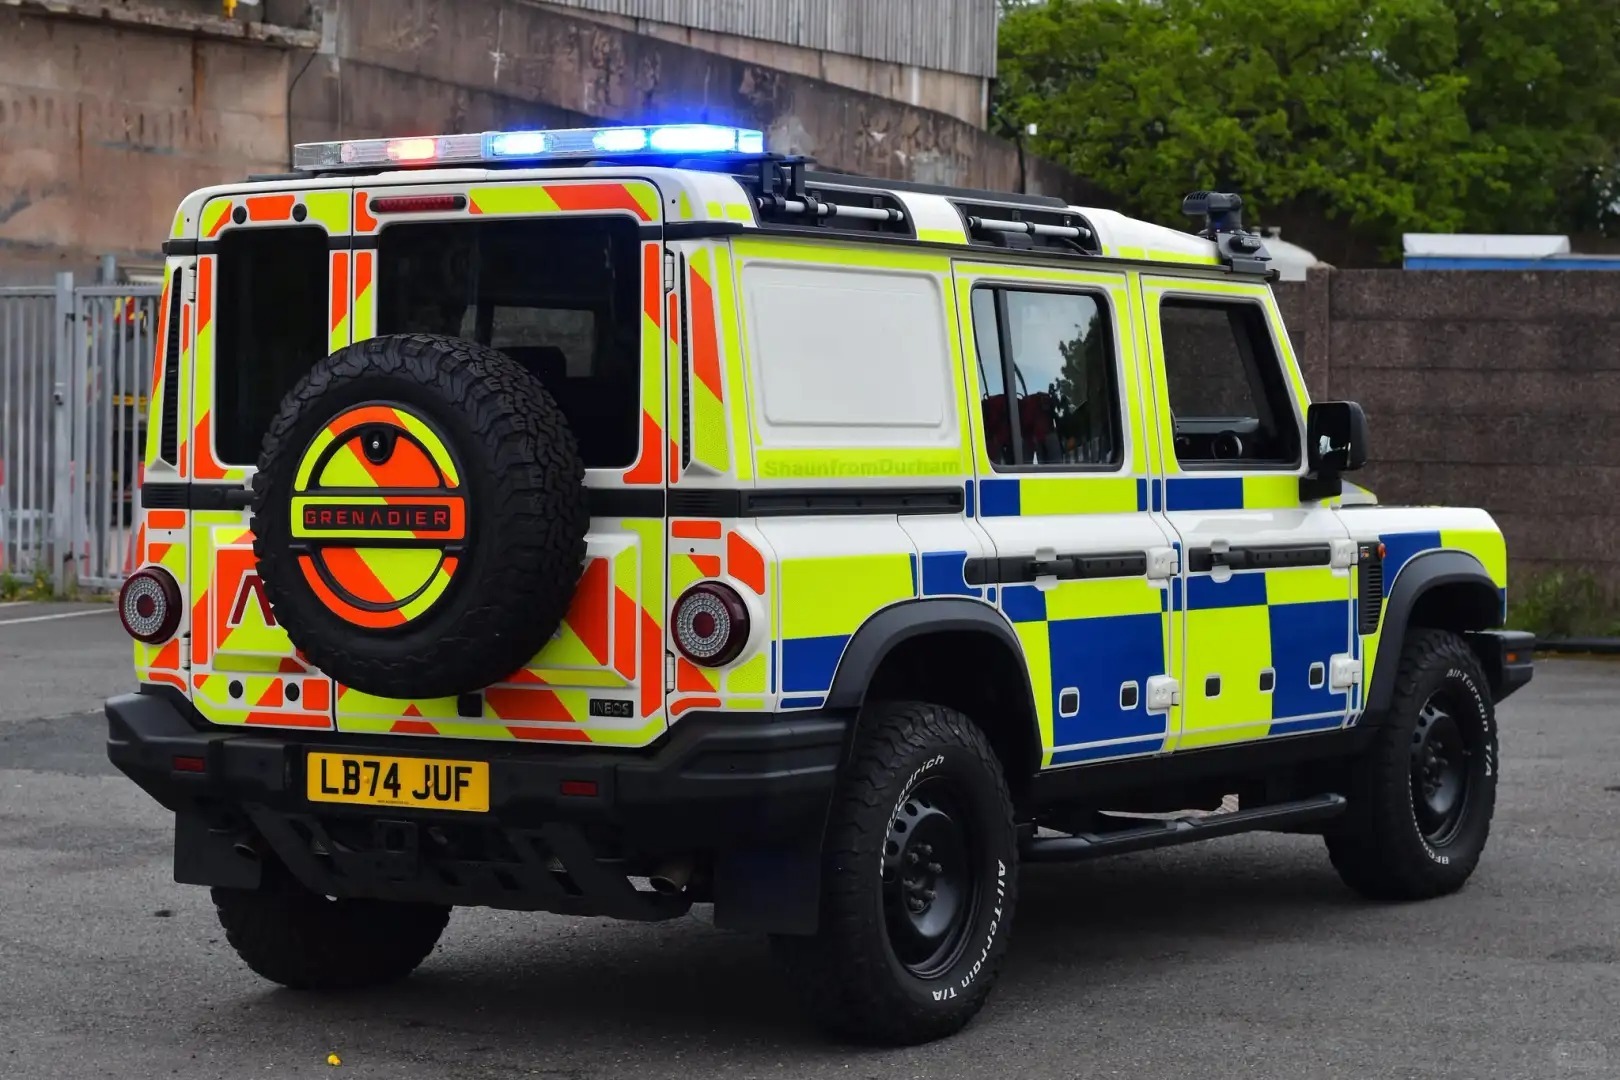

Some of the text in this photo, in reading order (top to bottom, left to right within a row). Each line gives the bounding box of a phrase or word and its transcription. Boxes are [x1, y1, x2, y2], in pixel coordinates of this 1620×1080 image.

[305, 510, 447, 525] GRENADIER
[593, 702, 629, 715] INEOS
[1446, 668, 1493, 776] All-Terrain T/A
[321, 759, 473, 802] LB74 JUF
[932, 859, 1006, 1001] All-Terrain T/A
